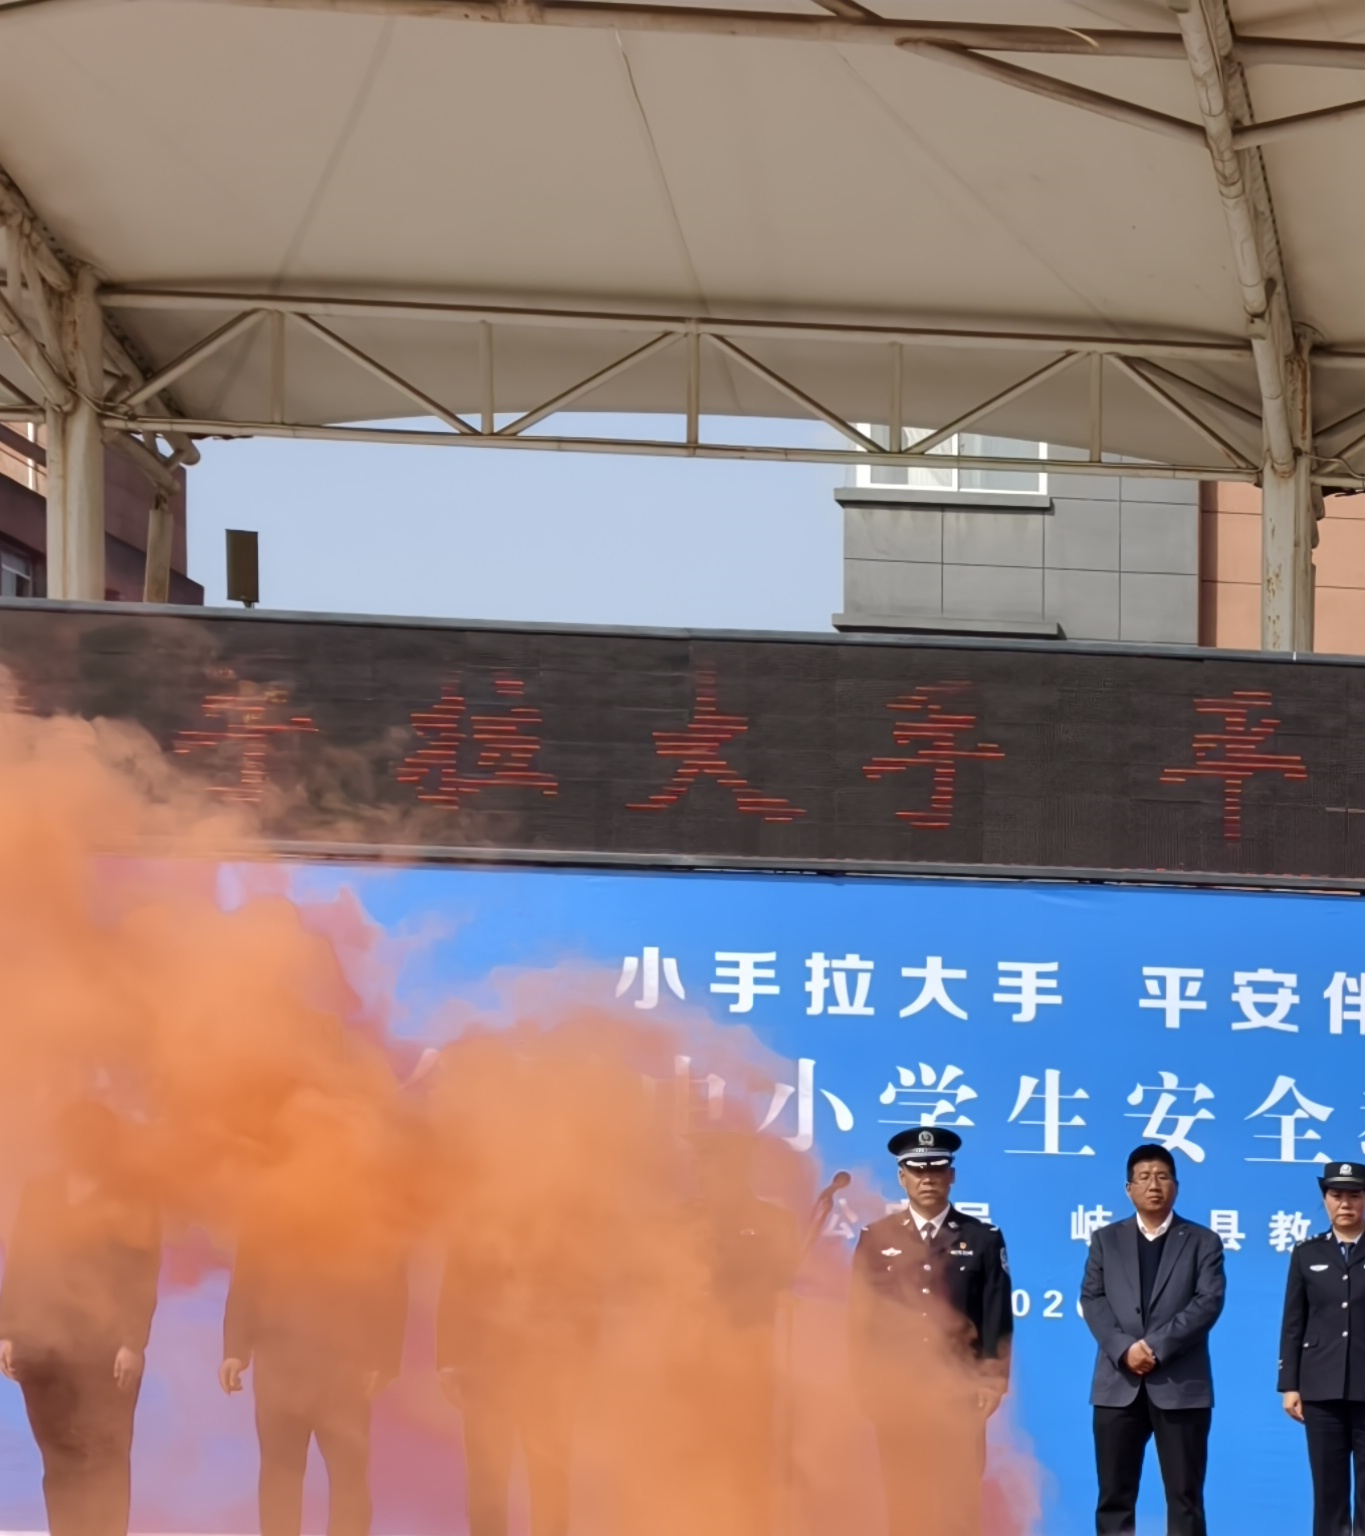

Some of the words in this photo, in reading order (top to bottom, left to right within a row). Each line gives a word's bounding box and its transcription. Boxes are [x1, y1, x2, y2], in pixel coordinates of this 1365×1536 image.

[615, 946, 1063, 1023] 小手拉大手
